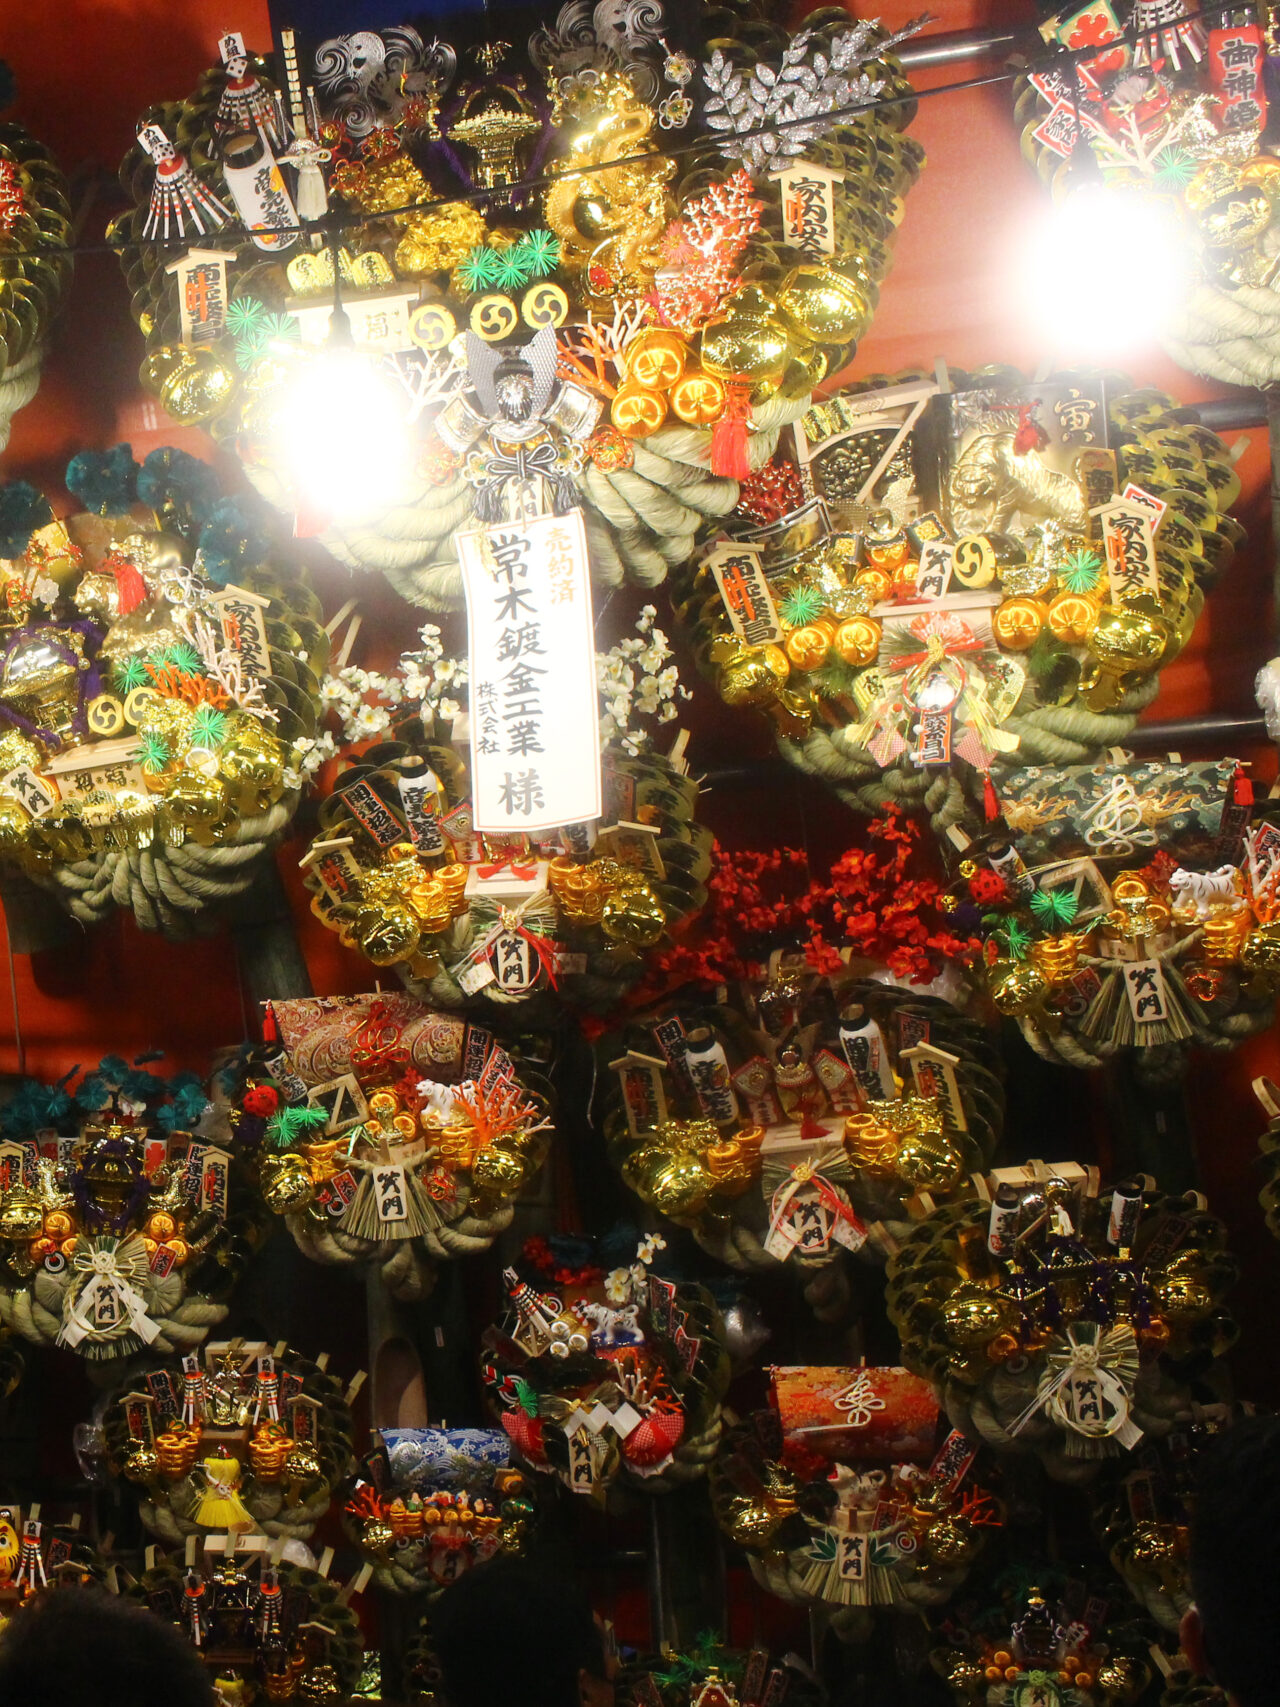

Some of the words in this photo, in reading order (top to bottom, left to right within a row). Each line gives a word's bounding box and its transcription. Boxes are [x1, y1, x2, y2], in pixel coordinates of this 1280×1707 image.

[1054, 388, 1097, 442] 寅
[545, 526, 577, 606] 売約済
[476, 680, 501, 756] 株式会社
[498, 768, 546, 816] 様
[1129, 966, 1164, 1019] 笑門
[376, 1170, 404, 1217] 笑門
